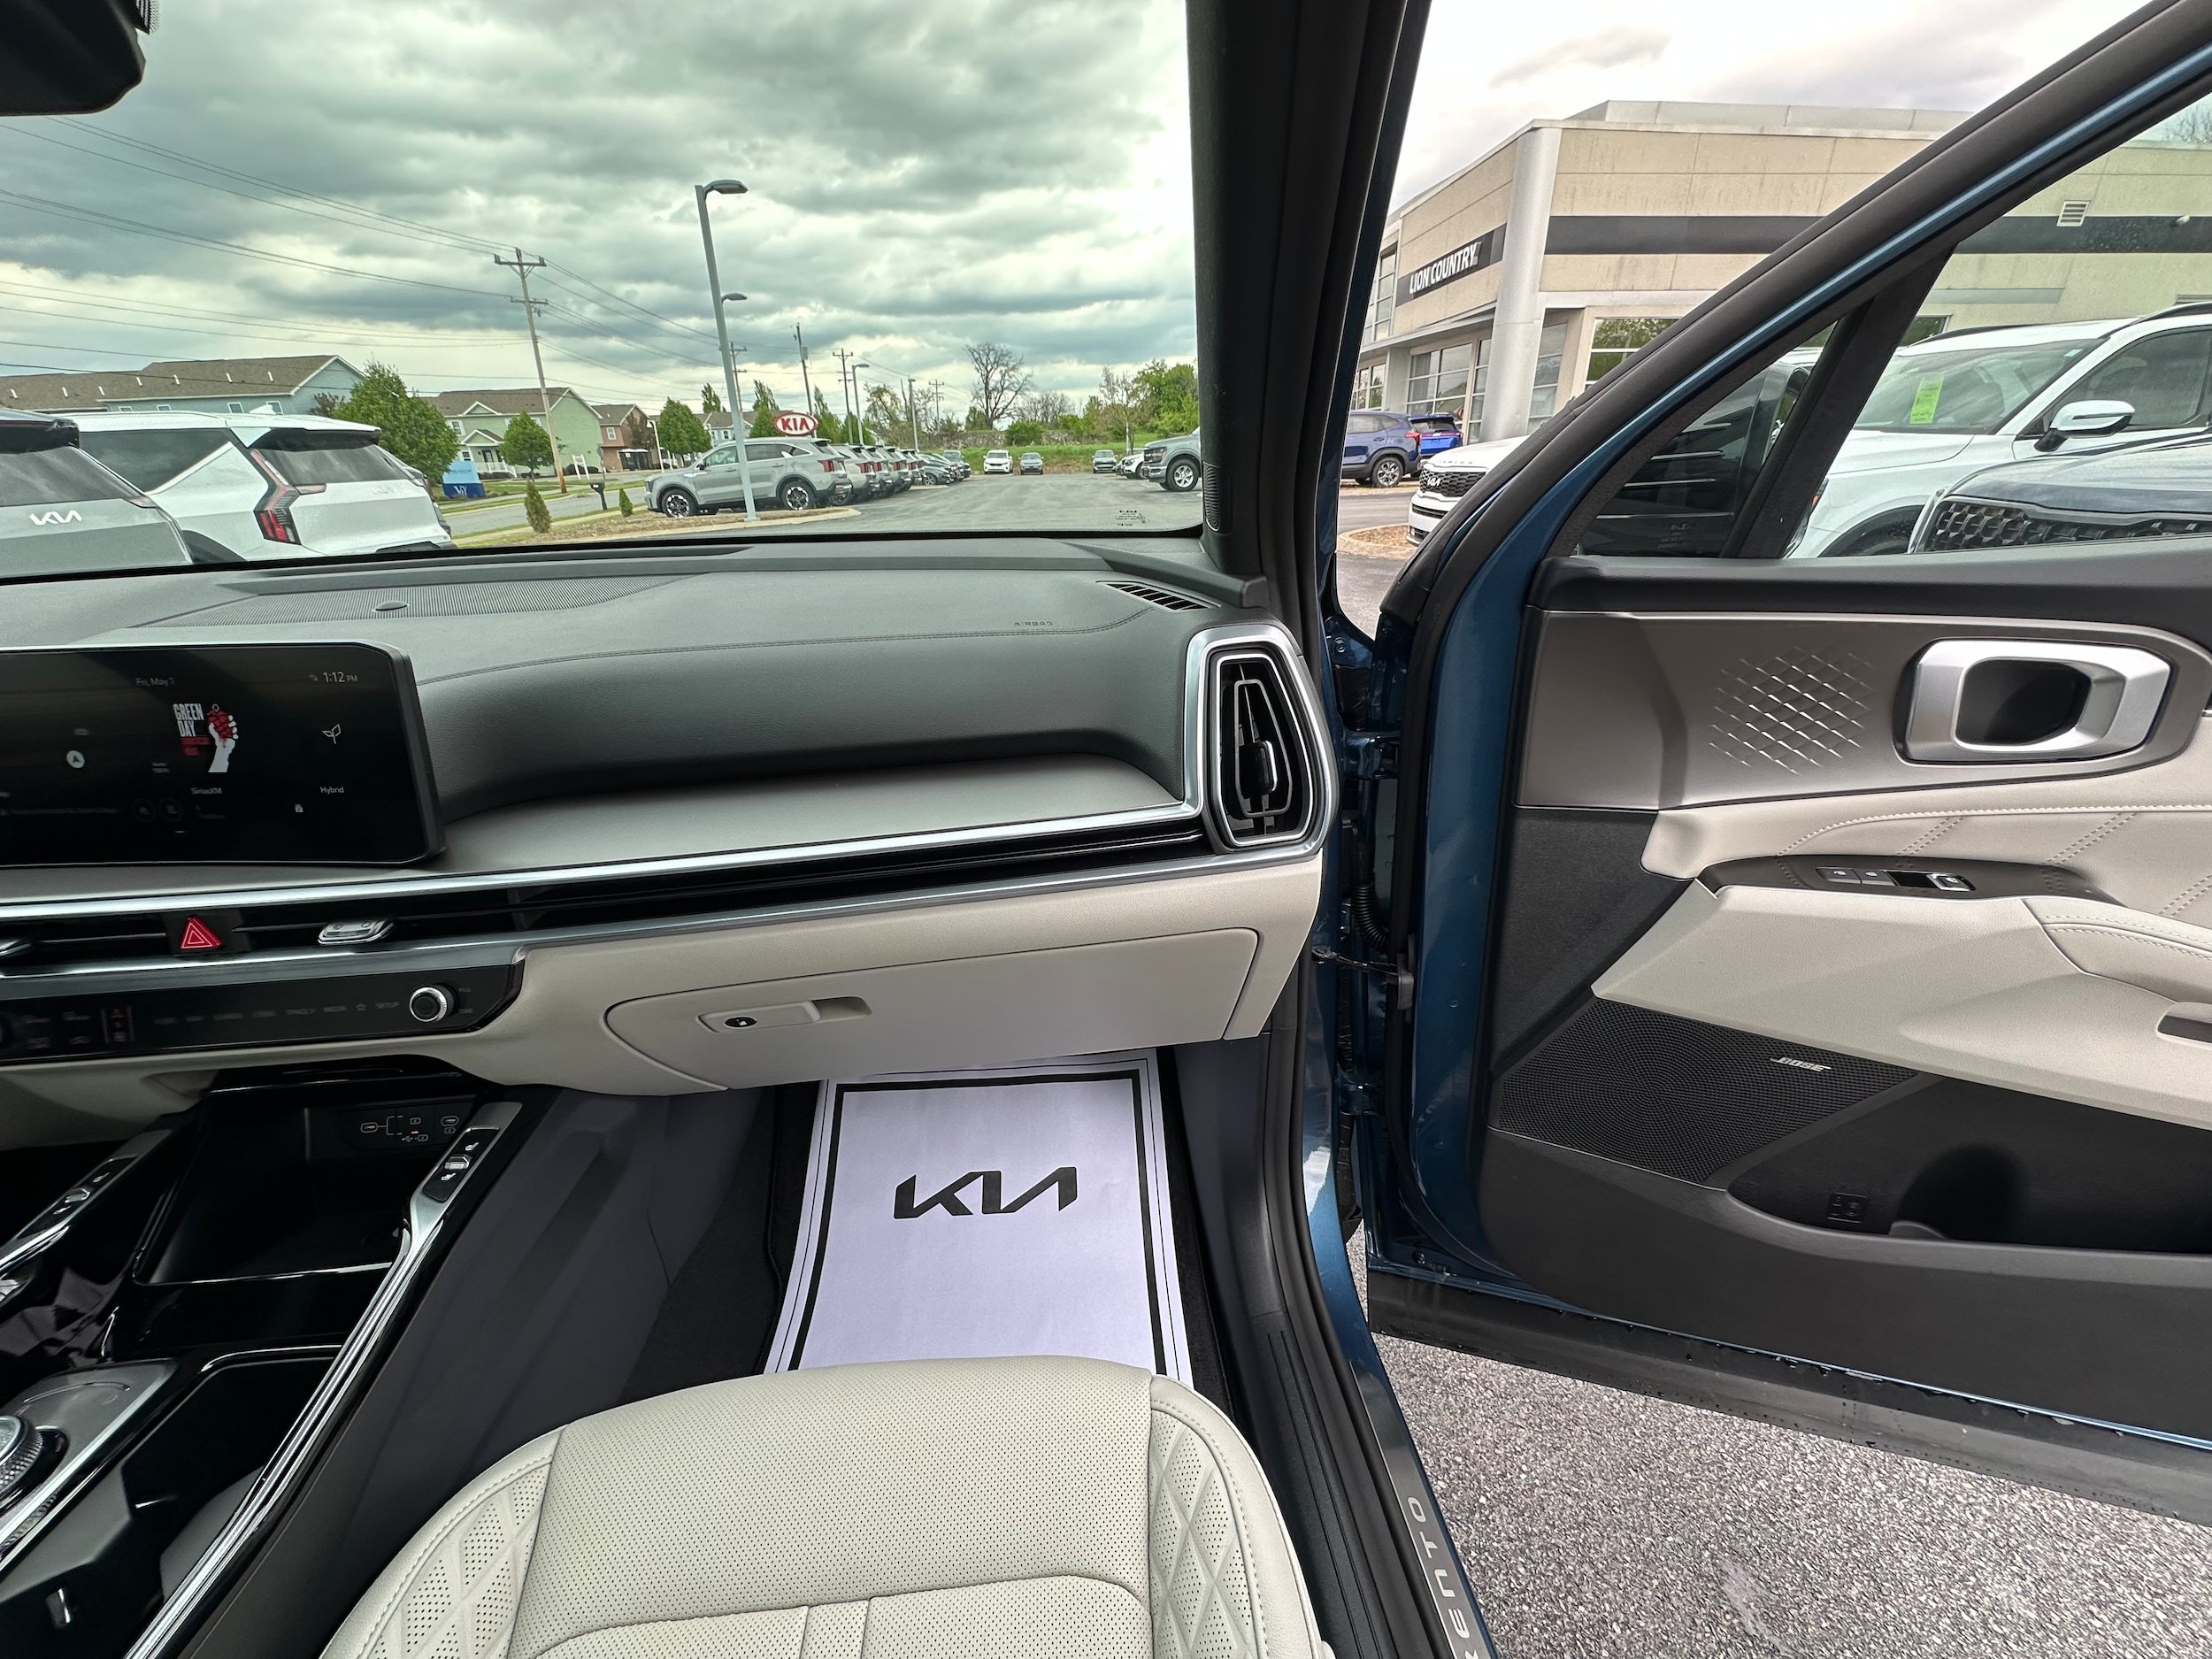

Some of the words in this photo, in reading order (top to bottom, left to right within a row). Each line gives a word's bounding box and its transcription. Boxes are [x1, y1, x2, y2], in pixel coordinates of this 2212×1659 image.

[1409, 266, 1432, 294] LION
[1430, 242, 1480, 284] COUNTRY
[780, 418, 810, 431] KIA
[28, 510, 83, 526] KIA
[323, 671, 346, 683] 1:12
[173, 703, 204, 720] GREEN
[177, 720, 196, 736] DAY
[319, 786, 345, 795] Hybrid
[1770, 1056, 1832, 1072] BOSE
[894, 1166, 1078, 1219] KIA
